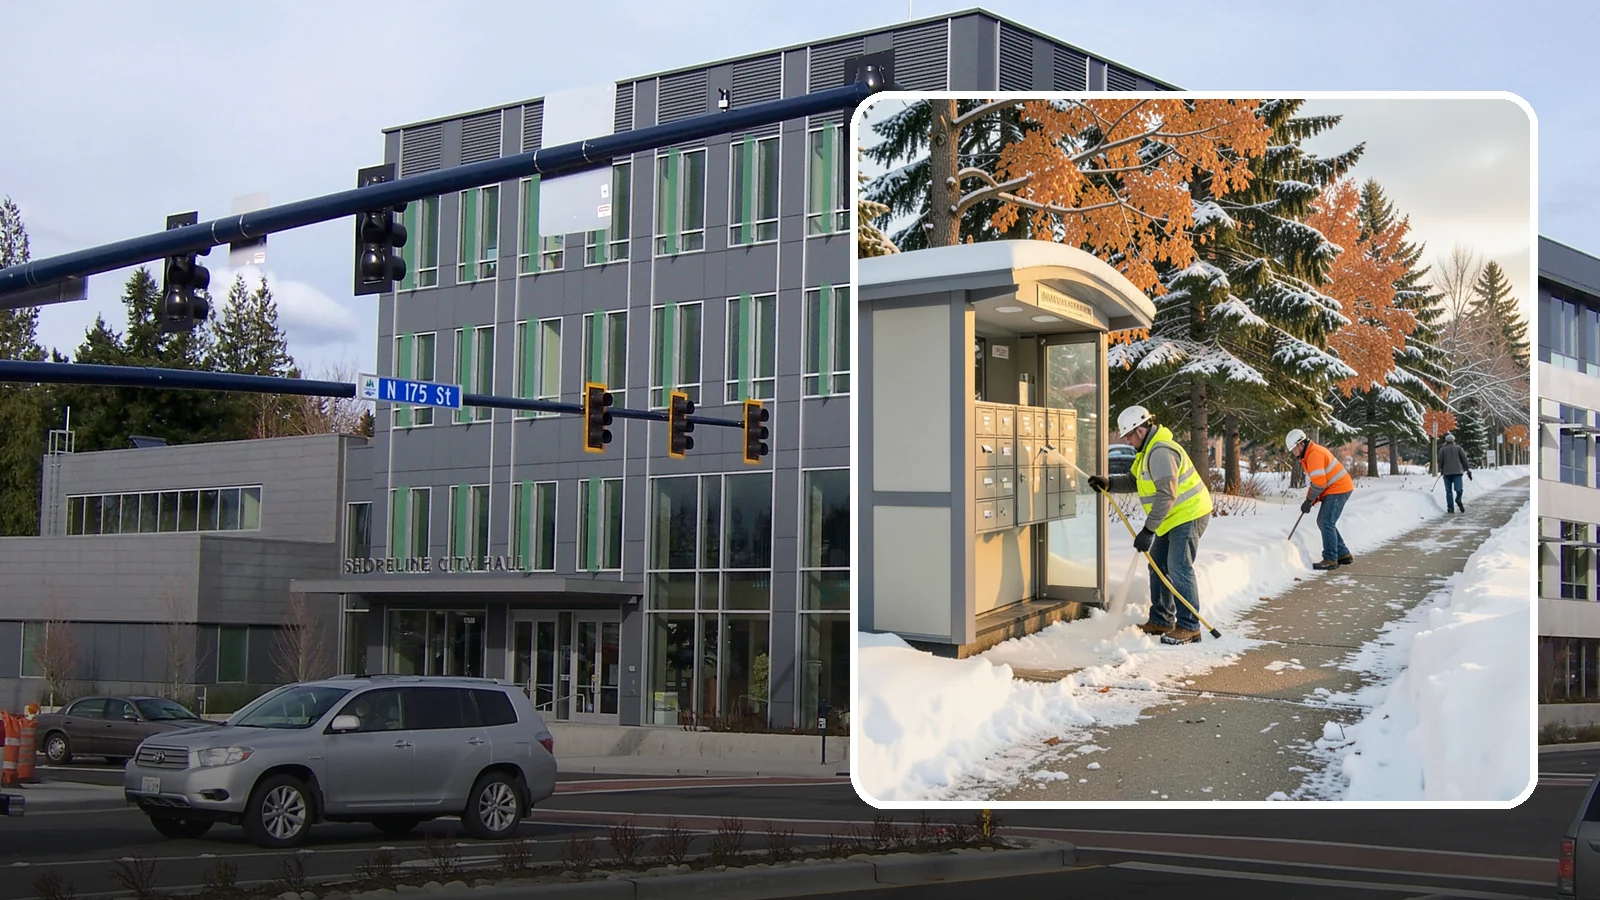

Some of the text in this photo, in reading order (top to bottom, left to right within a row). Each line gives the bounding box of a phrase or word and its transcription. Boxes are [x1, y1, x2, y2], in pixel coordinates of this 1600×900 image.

[387, 380, 451, 406] N 175 St
[344, 556, 525, 574] SHORELINE CITY HALL
